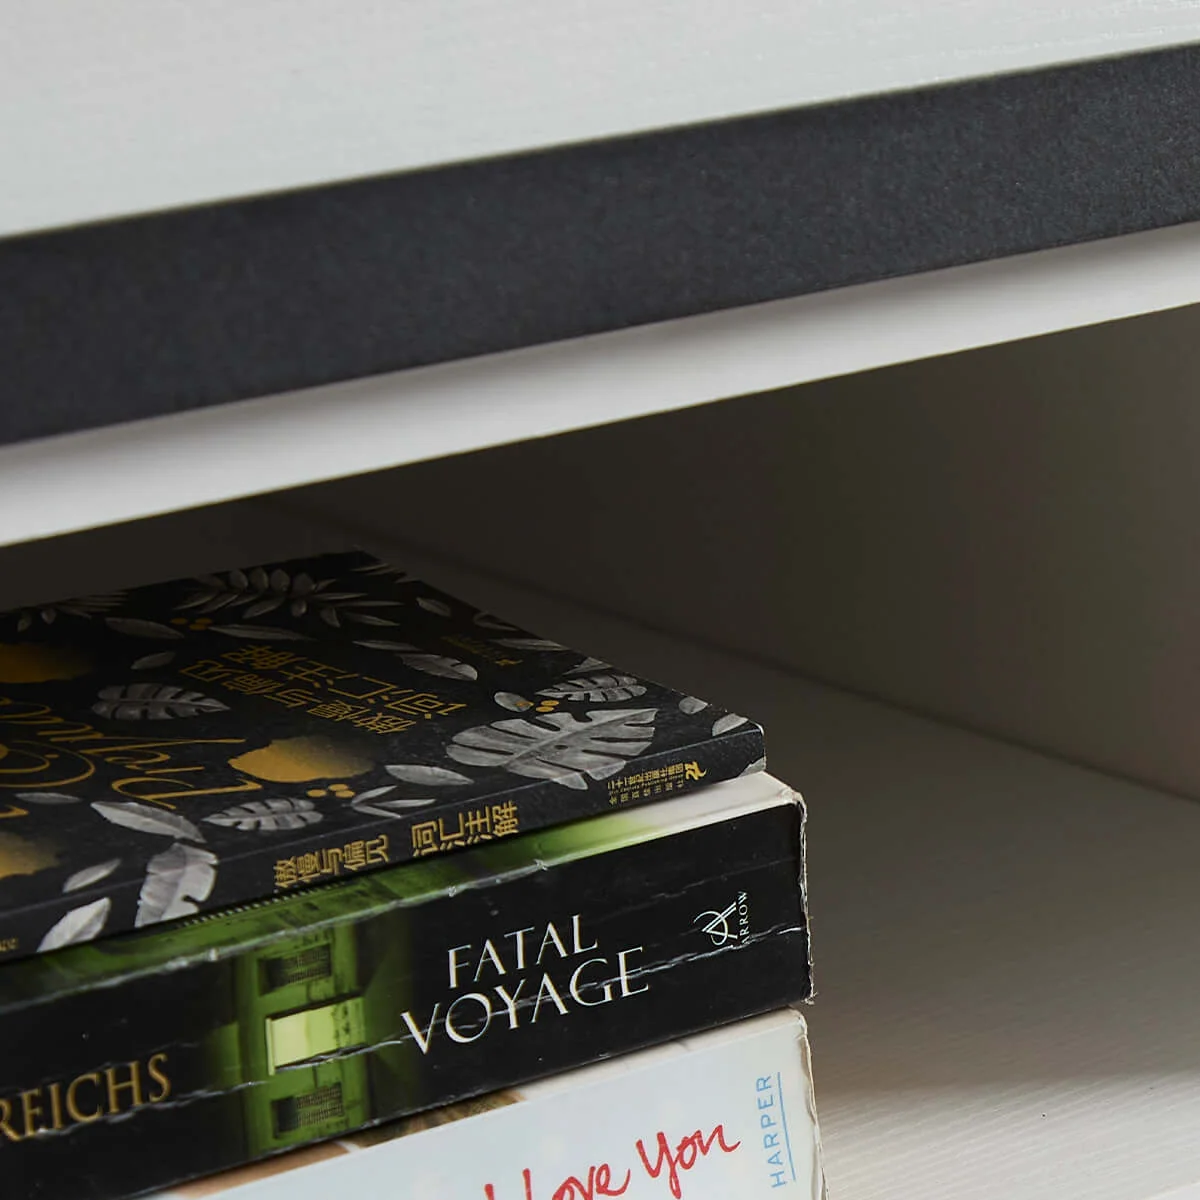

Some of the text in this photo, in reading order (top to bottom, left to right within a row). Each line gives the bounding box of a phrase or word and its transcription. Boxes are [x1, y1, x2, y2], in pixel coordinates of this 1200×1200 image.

[179, 659, 416, 734] 傲慢与偏见
[221, 645, 468, 717] 词汇注解
[273, 800, 520, 888] 傲慢与偏见 词汇注解
[447, 914, 598, 988] FATAL
[737, 891, 751, 945] ARROW
[400, 946, 649, 1055] VOYAGE
[755, 1074, 787, 1189] HARPER
